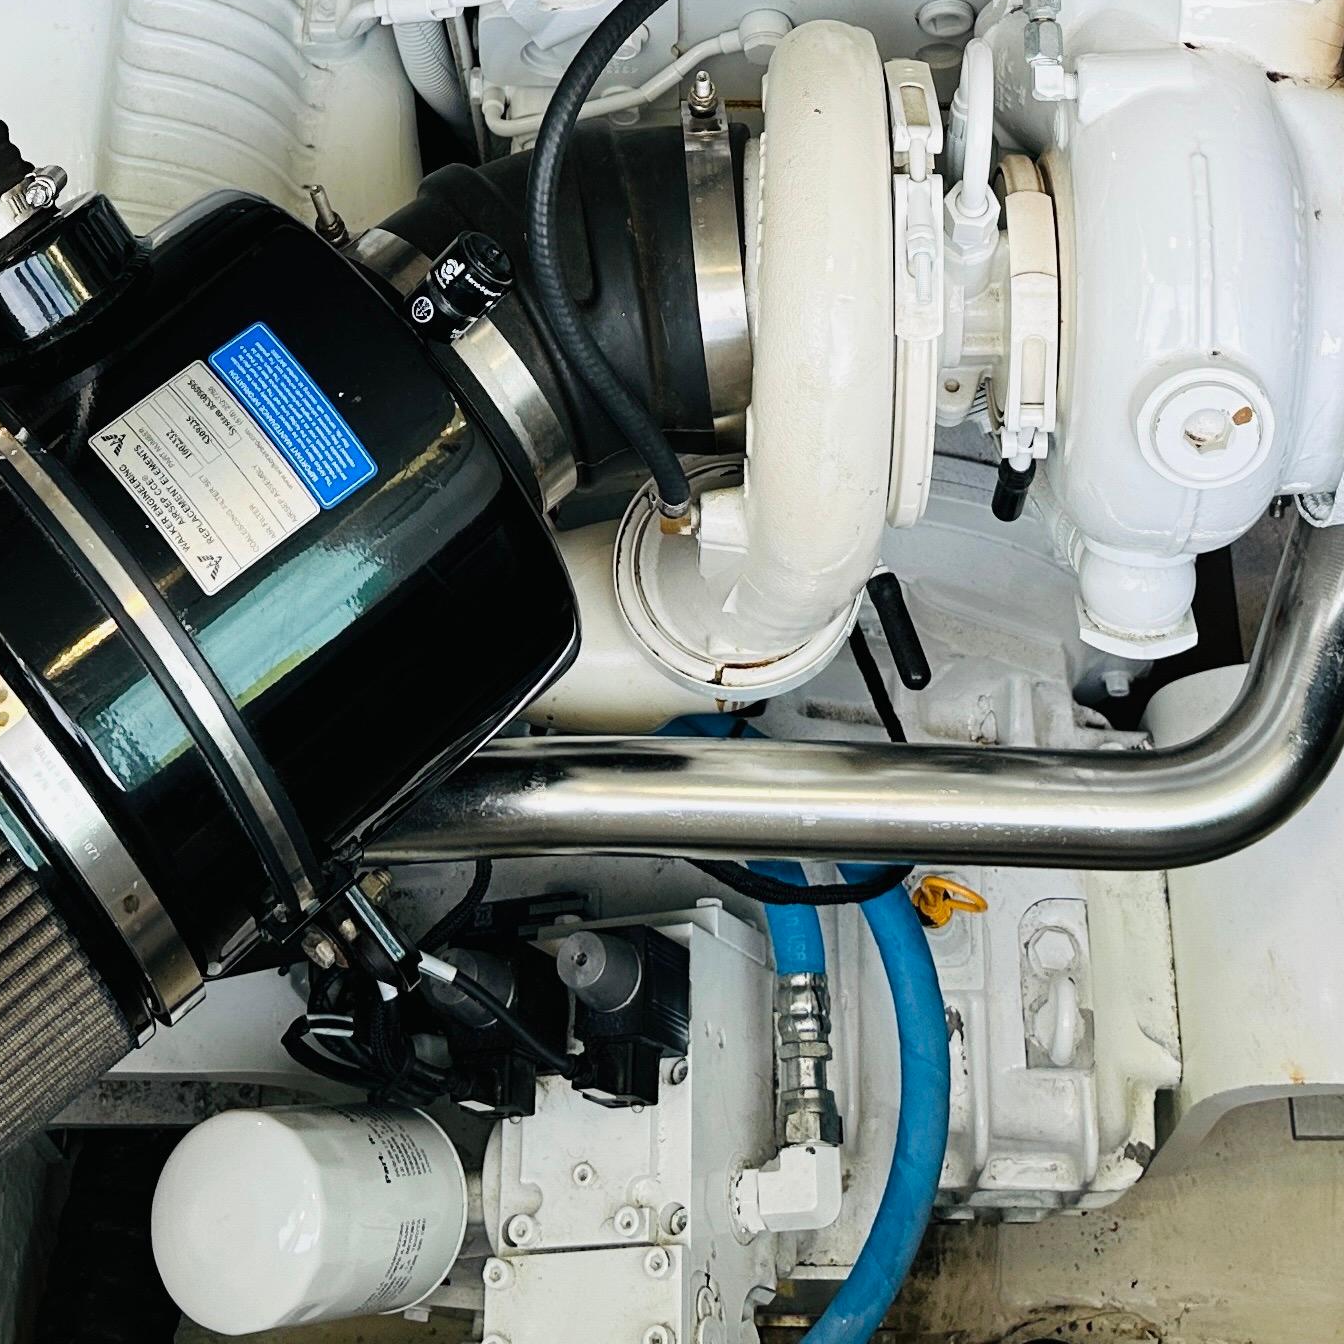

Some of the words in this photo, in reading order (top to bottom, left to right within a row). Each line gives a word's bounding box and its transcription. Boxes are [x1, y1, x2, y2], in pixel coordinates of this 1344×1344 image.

[228, 368, 262, 407] INFORMATION
[138, 426, 162, 452] NUMBER
[256, 404, 293, 448] MAINTENANCE
[132, 443, 169, 485] ELEMENTS
[158, 451, 175, 468] PART
[289, 445, 319, 482] IMPORTANT
[117, 463, 163, 516] ENGINEERING
[159, 495, 186, 526] AIRSEP
[165, 484, 215, 544] REPLACEMENT
[160, 516, 190, 552] WALKER
